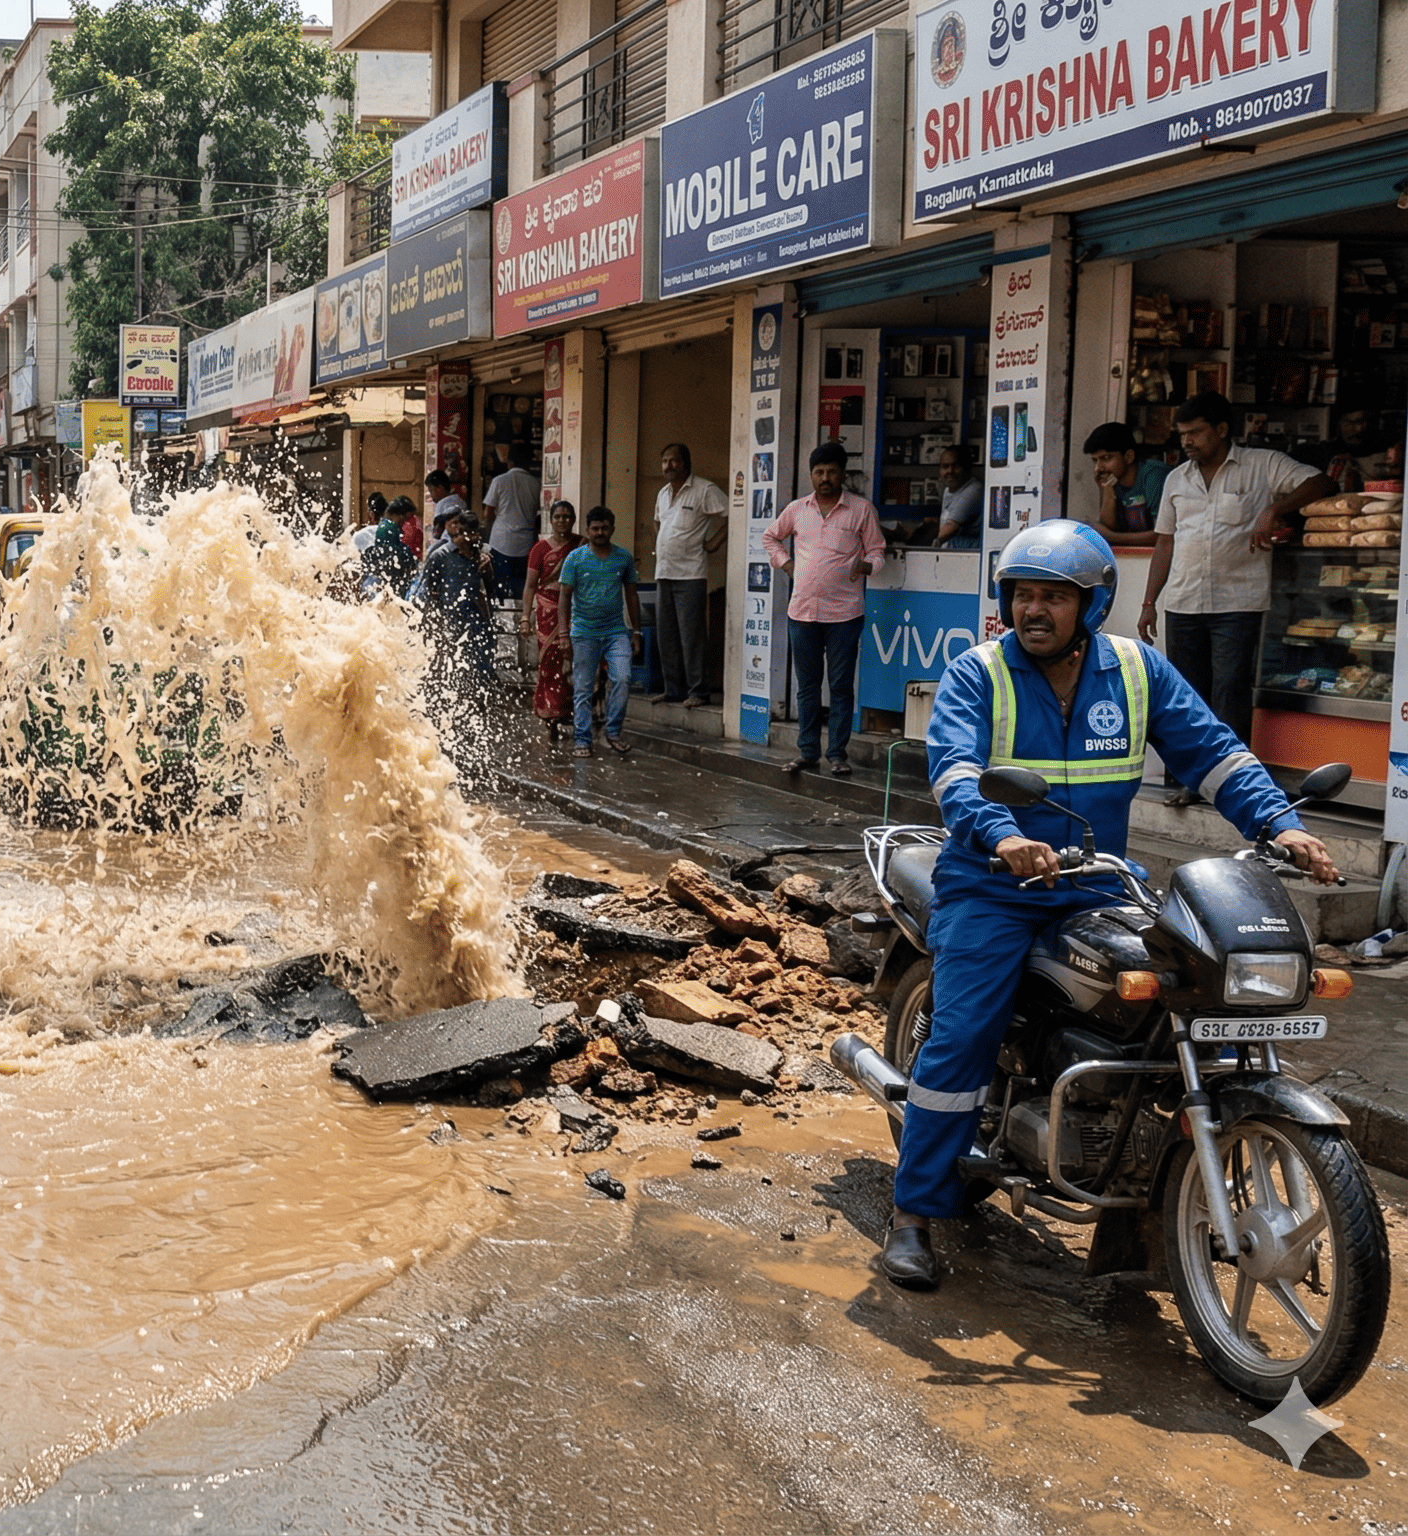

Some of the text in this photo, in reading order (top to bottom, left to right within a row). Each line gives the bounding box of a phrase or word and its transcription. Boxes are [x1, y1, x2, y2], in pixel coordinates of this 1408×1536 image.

[924, 97, 970, 170] SRI
[981, 39, 1134, 152] KRISHNA
[1147, 0, 1315, 101] BAKERY
[450, 128, 489, 177] BAKERY
[665, 147, 767, 238] MOBILE
[776, 111, 865, 201] CARE
[497, 257, 517, 297] SRI
[519, 236, 577, 290] KRISHNA
[579, 213, 639, 271] BAKERY
[872, 609, 976, 669] vivo
[1085, 738, 1128, 751] BWSSB
